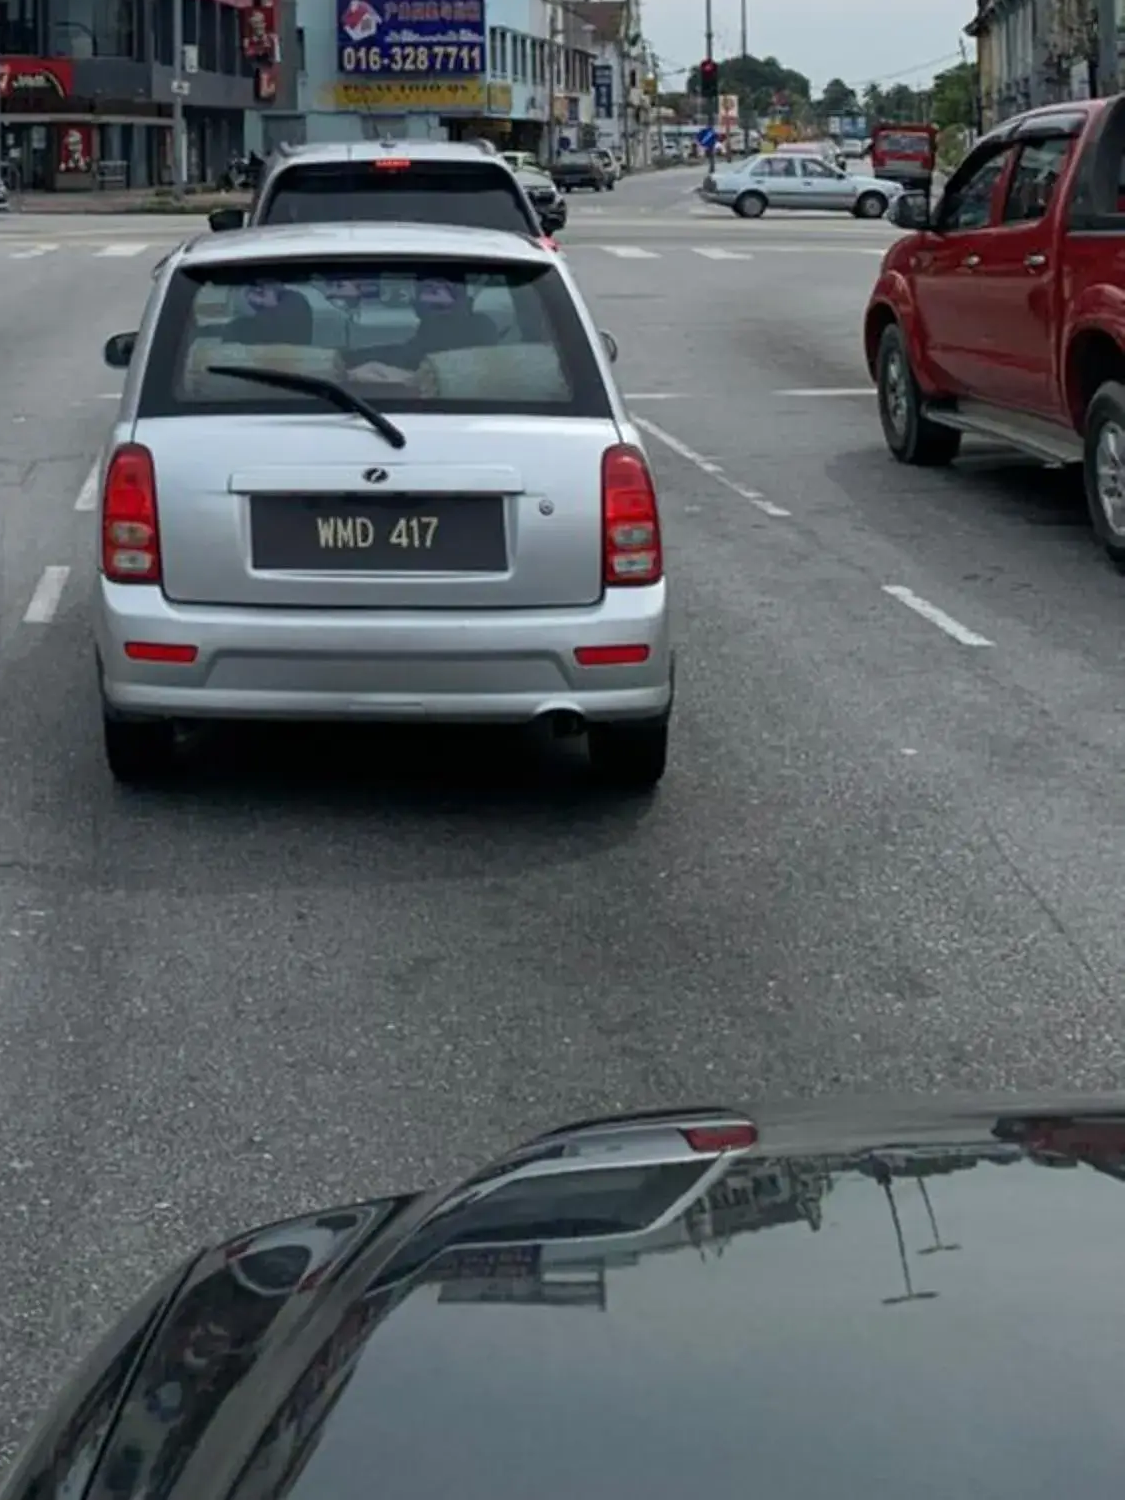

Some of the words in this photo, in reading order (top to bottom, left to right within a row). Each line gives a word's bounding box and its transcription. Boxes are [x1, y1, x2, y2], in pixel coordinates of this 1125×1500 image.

[433, 47, 481, 70] 7711
[316, 516, 374, 549] WMD
[389, 516, 439, 548] 417
